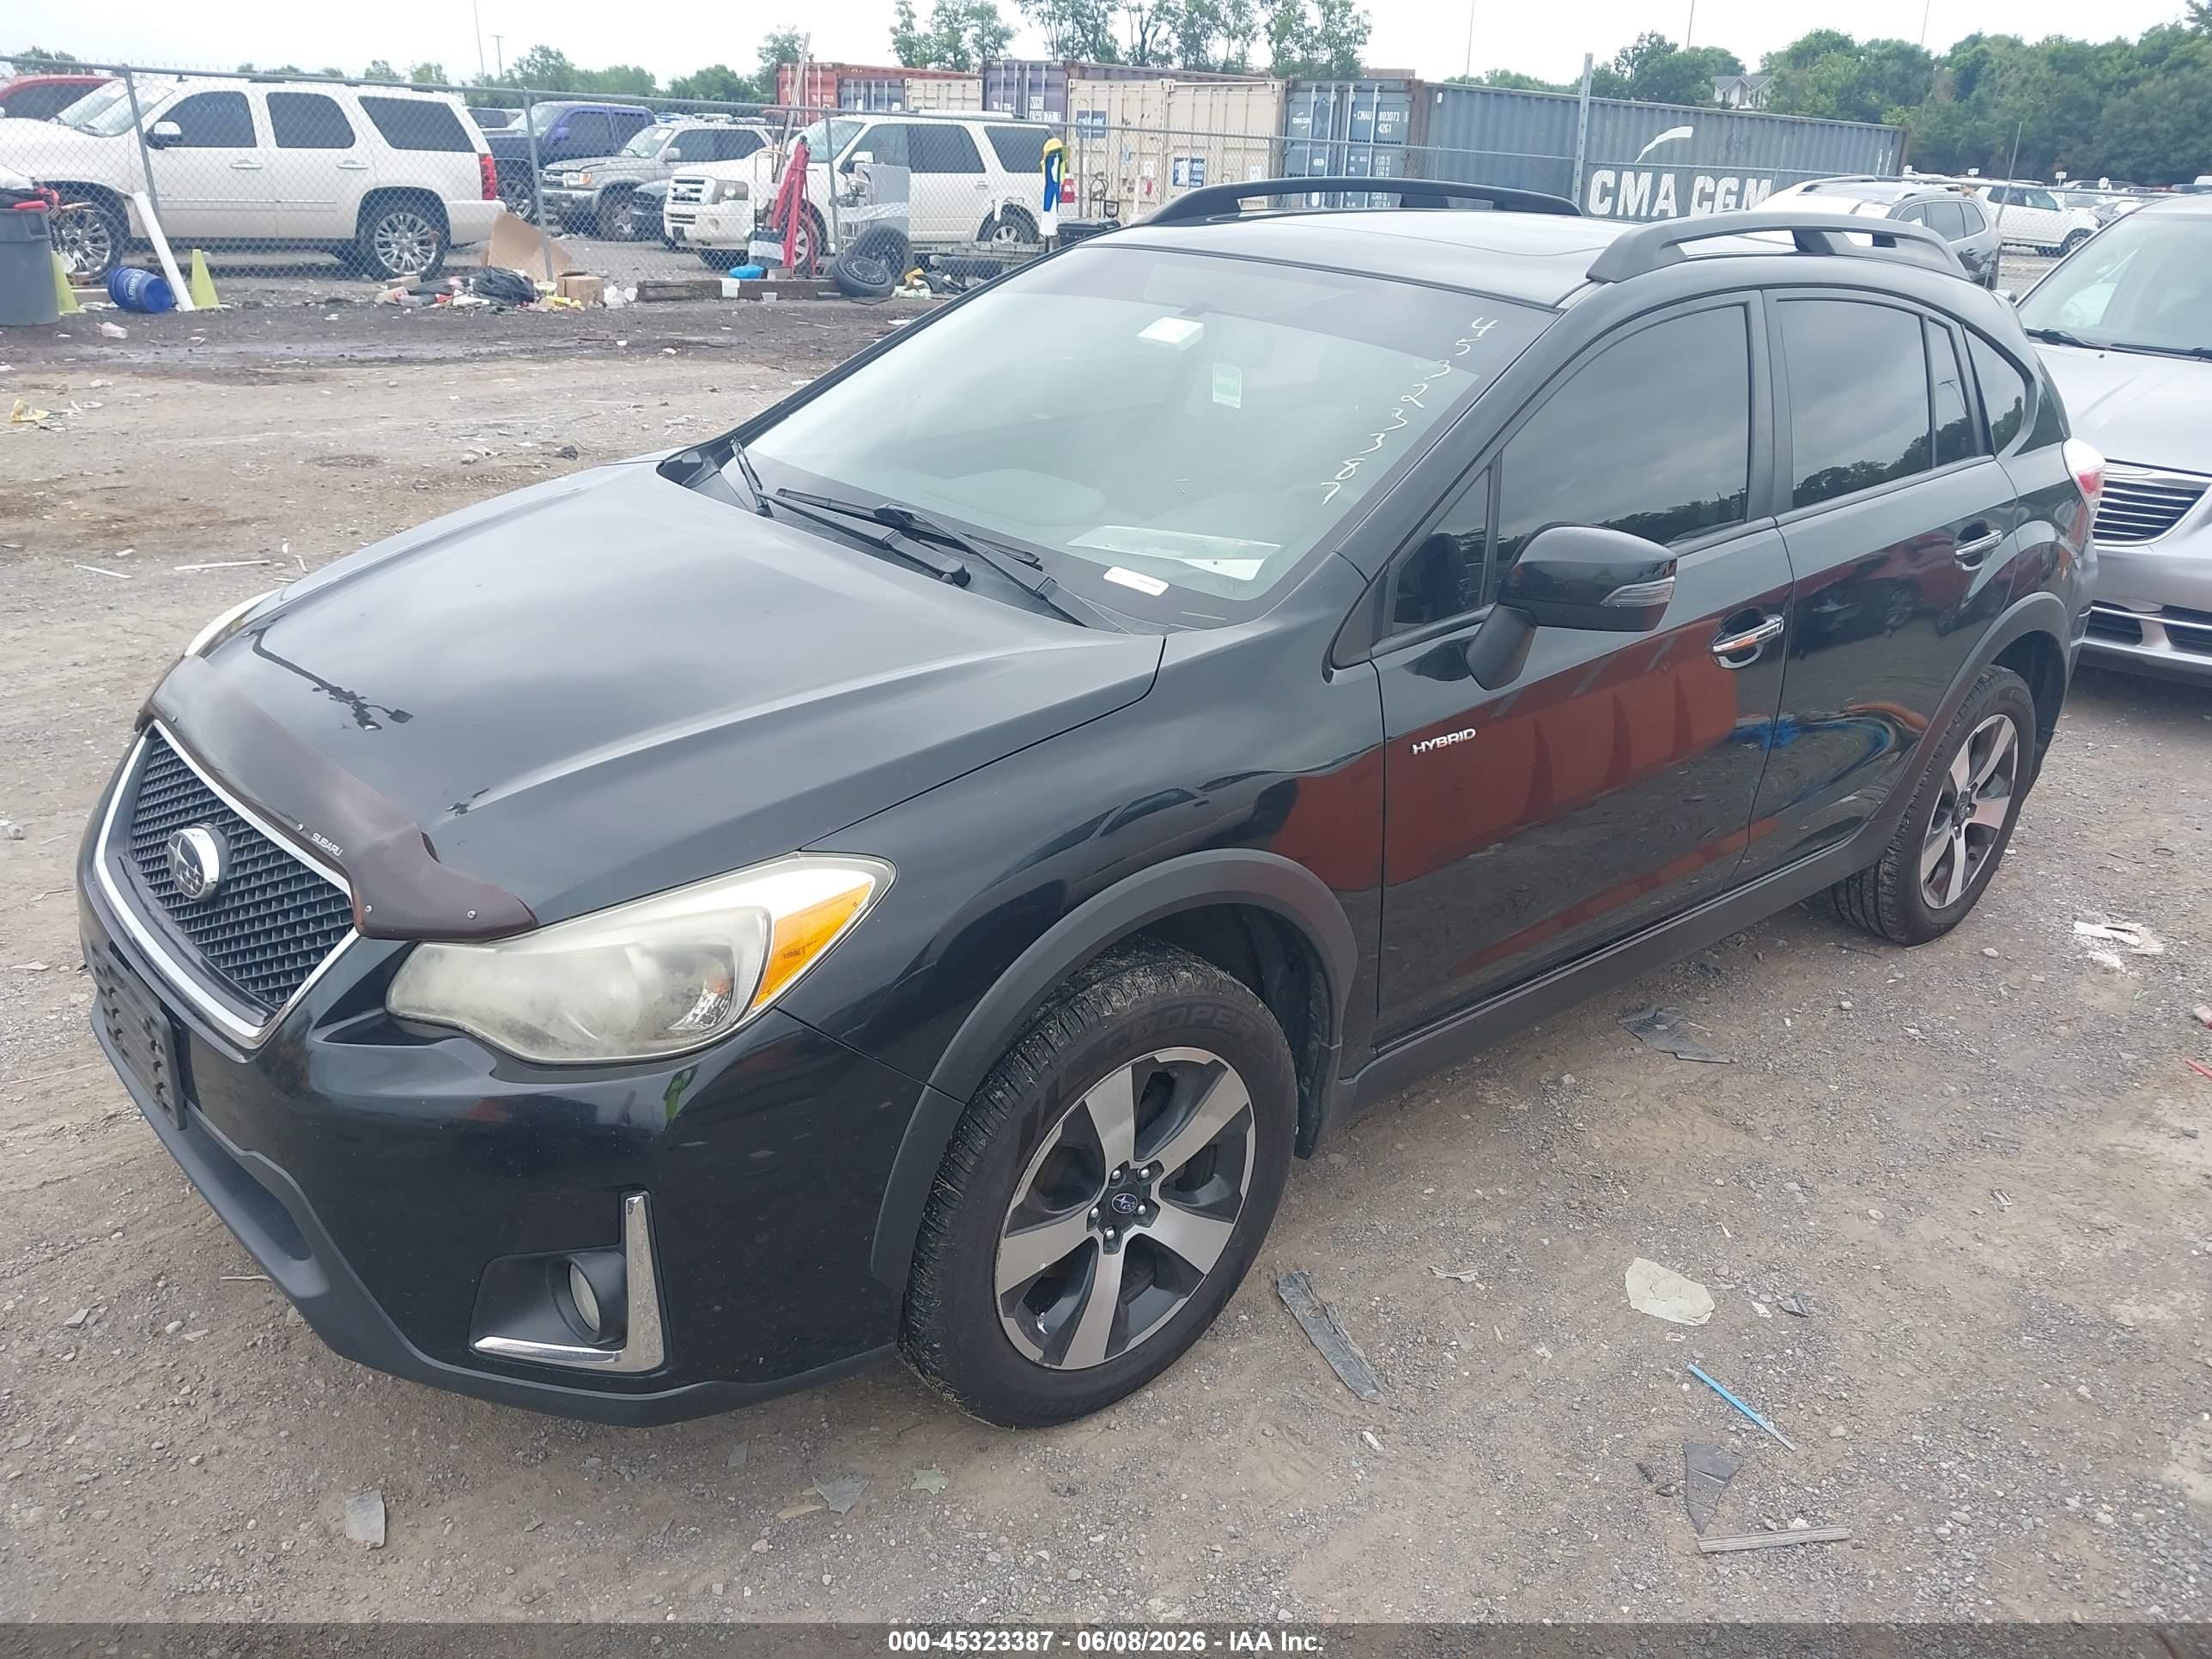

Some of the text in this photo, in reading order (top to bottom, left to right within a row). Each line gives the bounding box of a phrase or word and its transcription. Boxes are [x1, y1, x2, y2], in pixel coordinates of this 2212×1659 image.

[1589, 170, 1772, 217] CMA CGM
[1412, 727, 1477, 756] HYBRID
[310, 831, 343, 857] SUBARU
